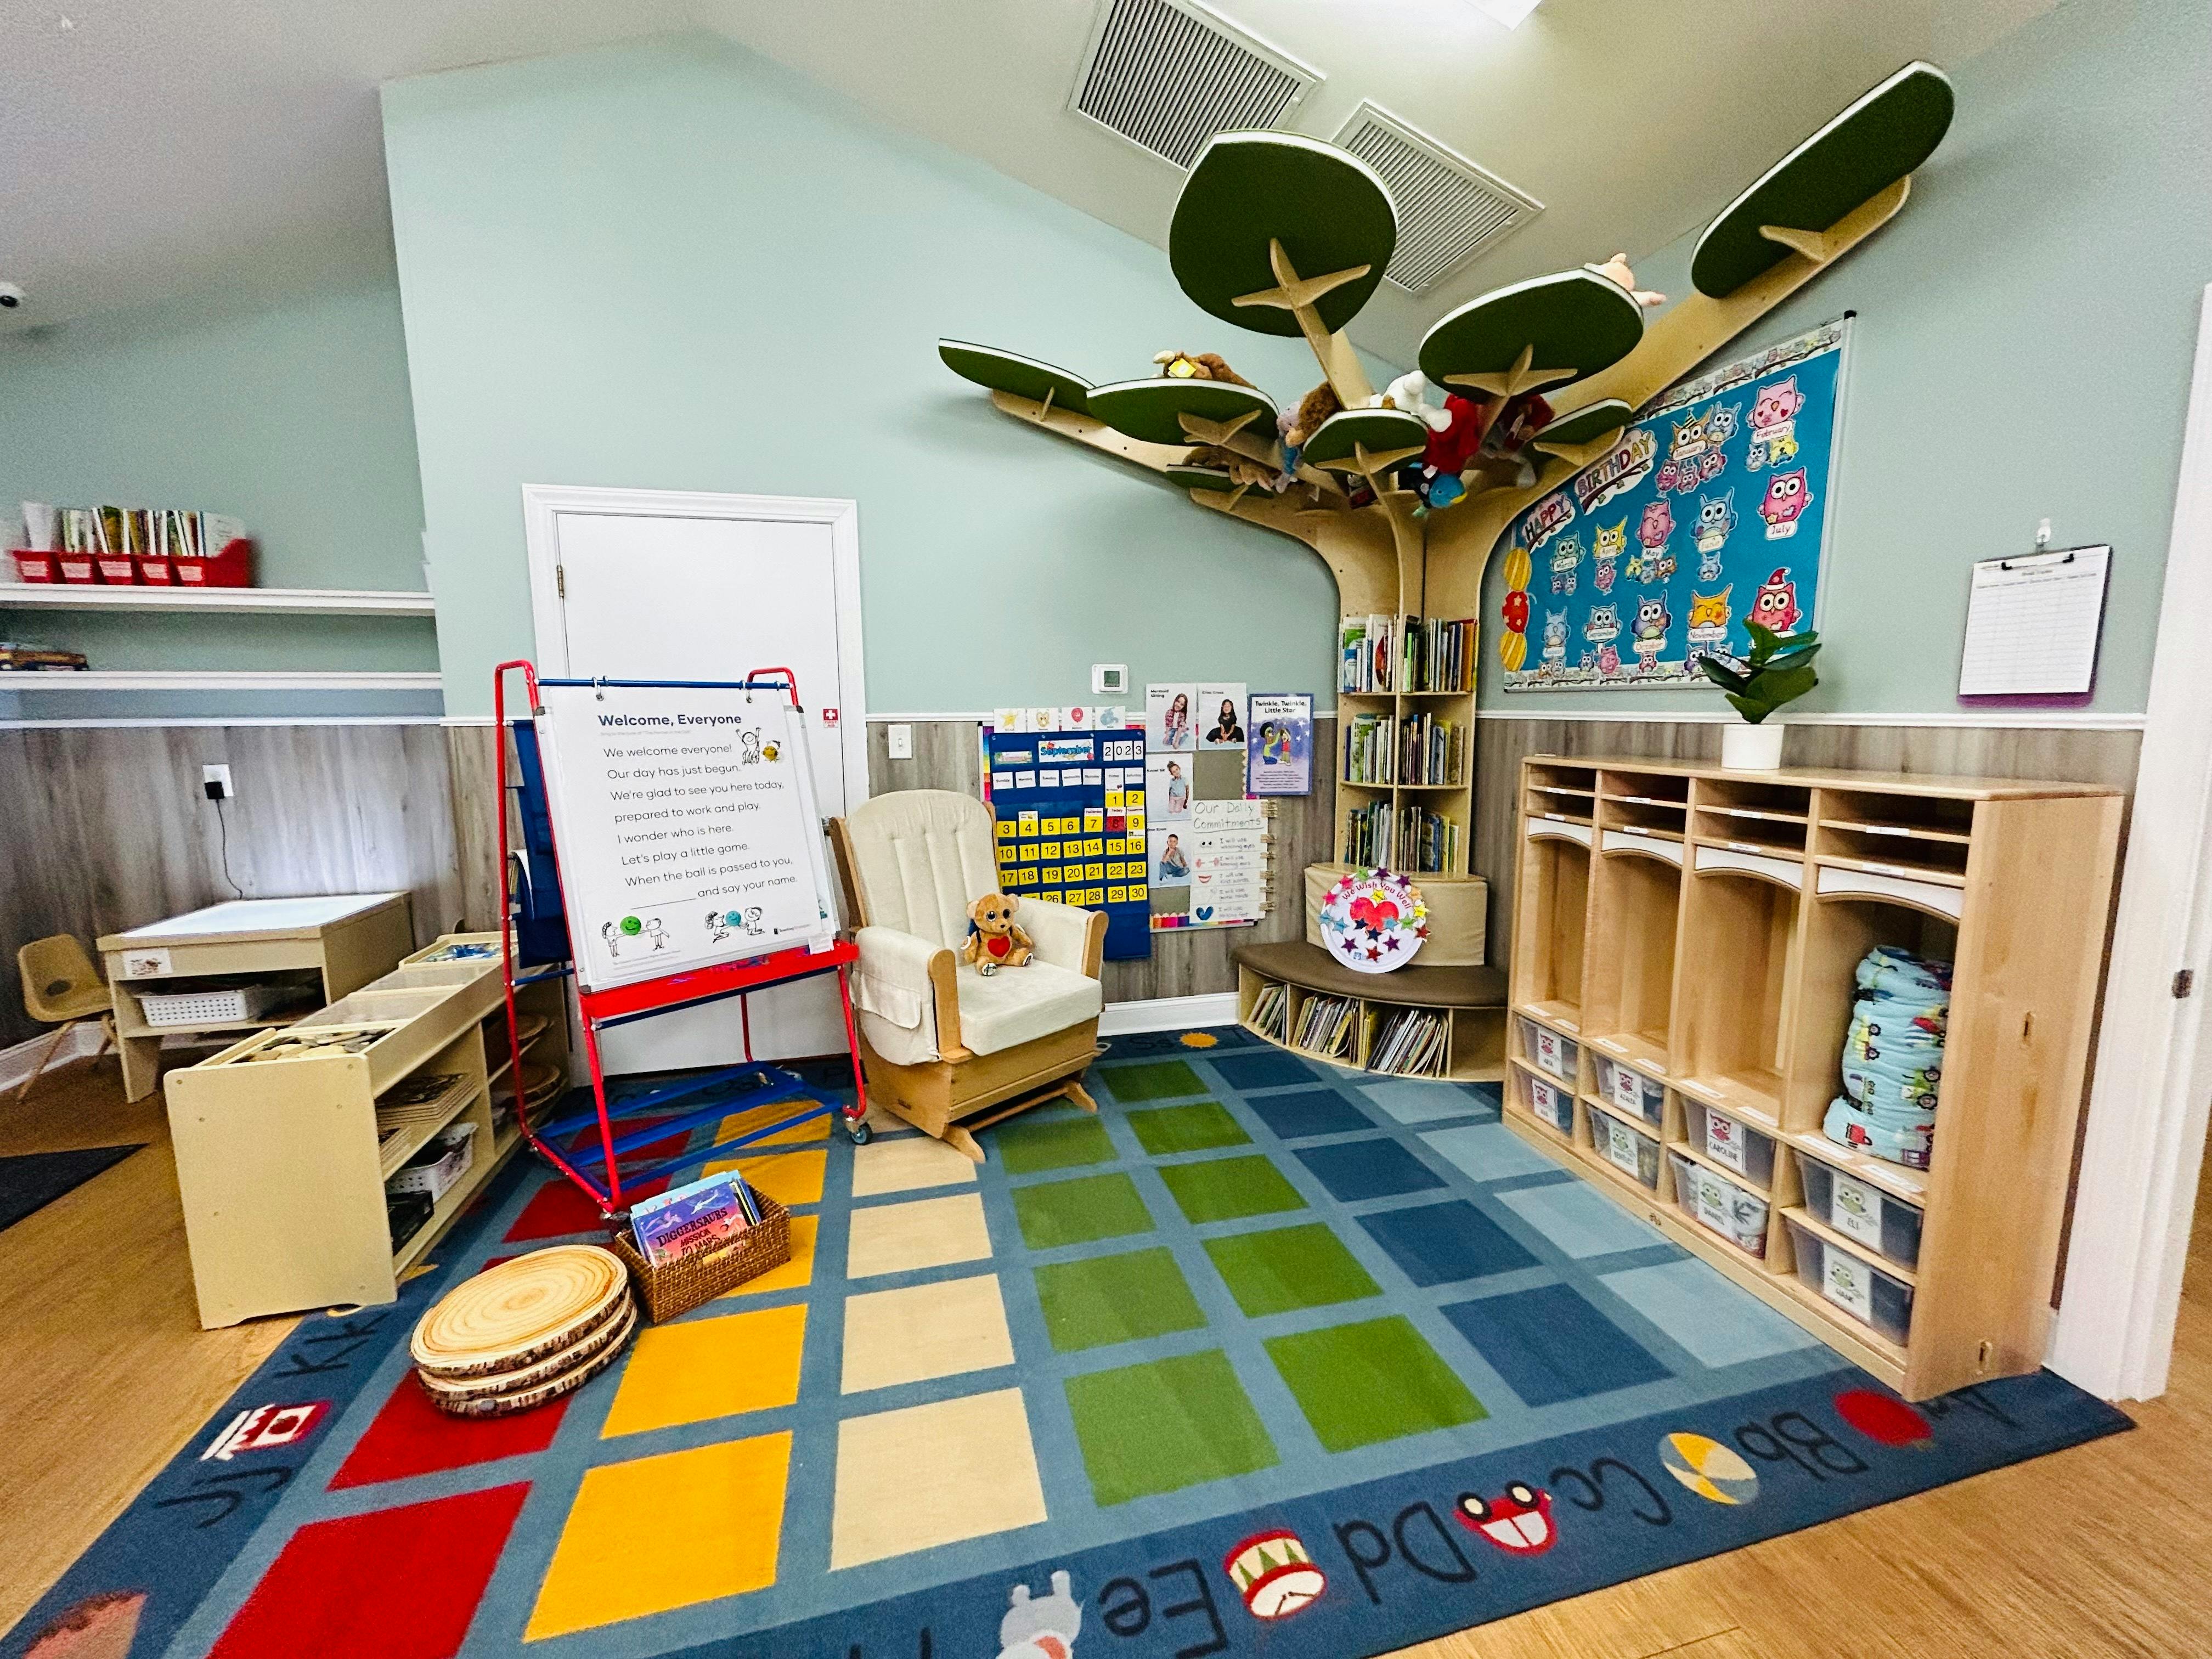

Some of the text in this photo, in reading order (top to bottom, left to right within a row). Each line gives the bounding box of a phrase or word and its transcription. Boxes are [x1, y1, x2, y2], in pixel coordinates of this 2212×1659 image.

[1757, 425, 1790, 438] February
[1577, 431, 1652, 498] BIRTHDAY
[1525, 495, 1565, 540] HAPPY
[1771, 524, 1791, 535] July
[597, 714, 742, 726] Welcome, Everyone
[603, 744, 733, 757] We welcome everyone!
[1040, 744, 1092, 757] September
[607, 764, 741, 779] Our day has just begun.
[610, 780, 785, 800] We're glad to see you here today,
[1113, 794, 1138, 805] 1 2
[614, 802, 761, 825] prepared to work and play.
[1195, 802, 1255, 815] Our Daily
[1003, 818, 1139, 833] 3 4 5 6 7 8 9
[1193, 817, 1261, 830] Commitments
[618, 825, 734, 844] I wonder who is here.
[622, 854, 650, 865] Let's
[653, 851, 677, 863] play
[691, 846, 715, 856] little
[718, 843, 750, 855] game.
[1000, 841, 1142, 859] 10 11 12 13 14 15 16
[625, 857, 793, 887] When the ball is passed to you,
[1001, 865, 1143, 883] 17 18 19 20 21 22 23
[697, 876, 798, 898] and say your name.
[1046, 894, 1059, 903] 26
[1069, 893, 1081, 902] 27
[1089, 891, 1101, 901] 28
[1111, 890, 1124, 899] 29
[1132, 888, 1144, 898] 30
[1342, 881, 1412, 910] We Wish You Well
[656, 1207, 728, 1248] DIGGERSAURS
[1847, 1217, 1859, 1231] ELI
[680, 1228, 712, 1248] MISSION
[1734, 1411, 1867, 1481] Bb
[1549, 1458, 1673, 1526] Cc
[1333, 1501, 1477, 1605] Dd
[1099, 1558, 1229, 1659] Ee
